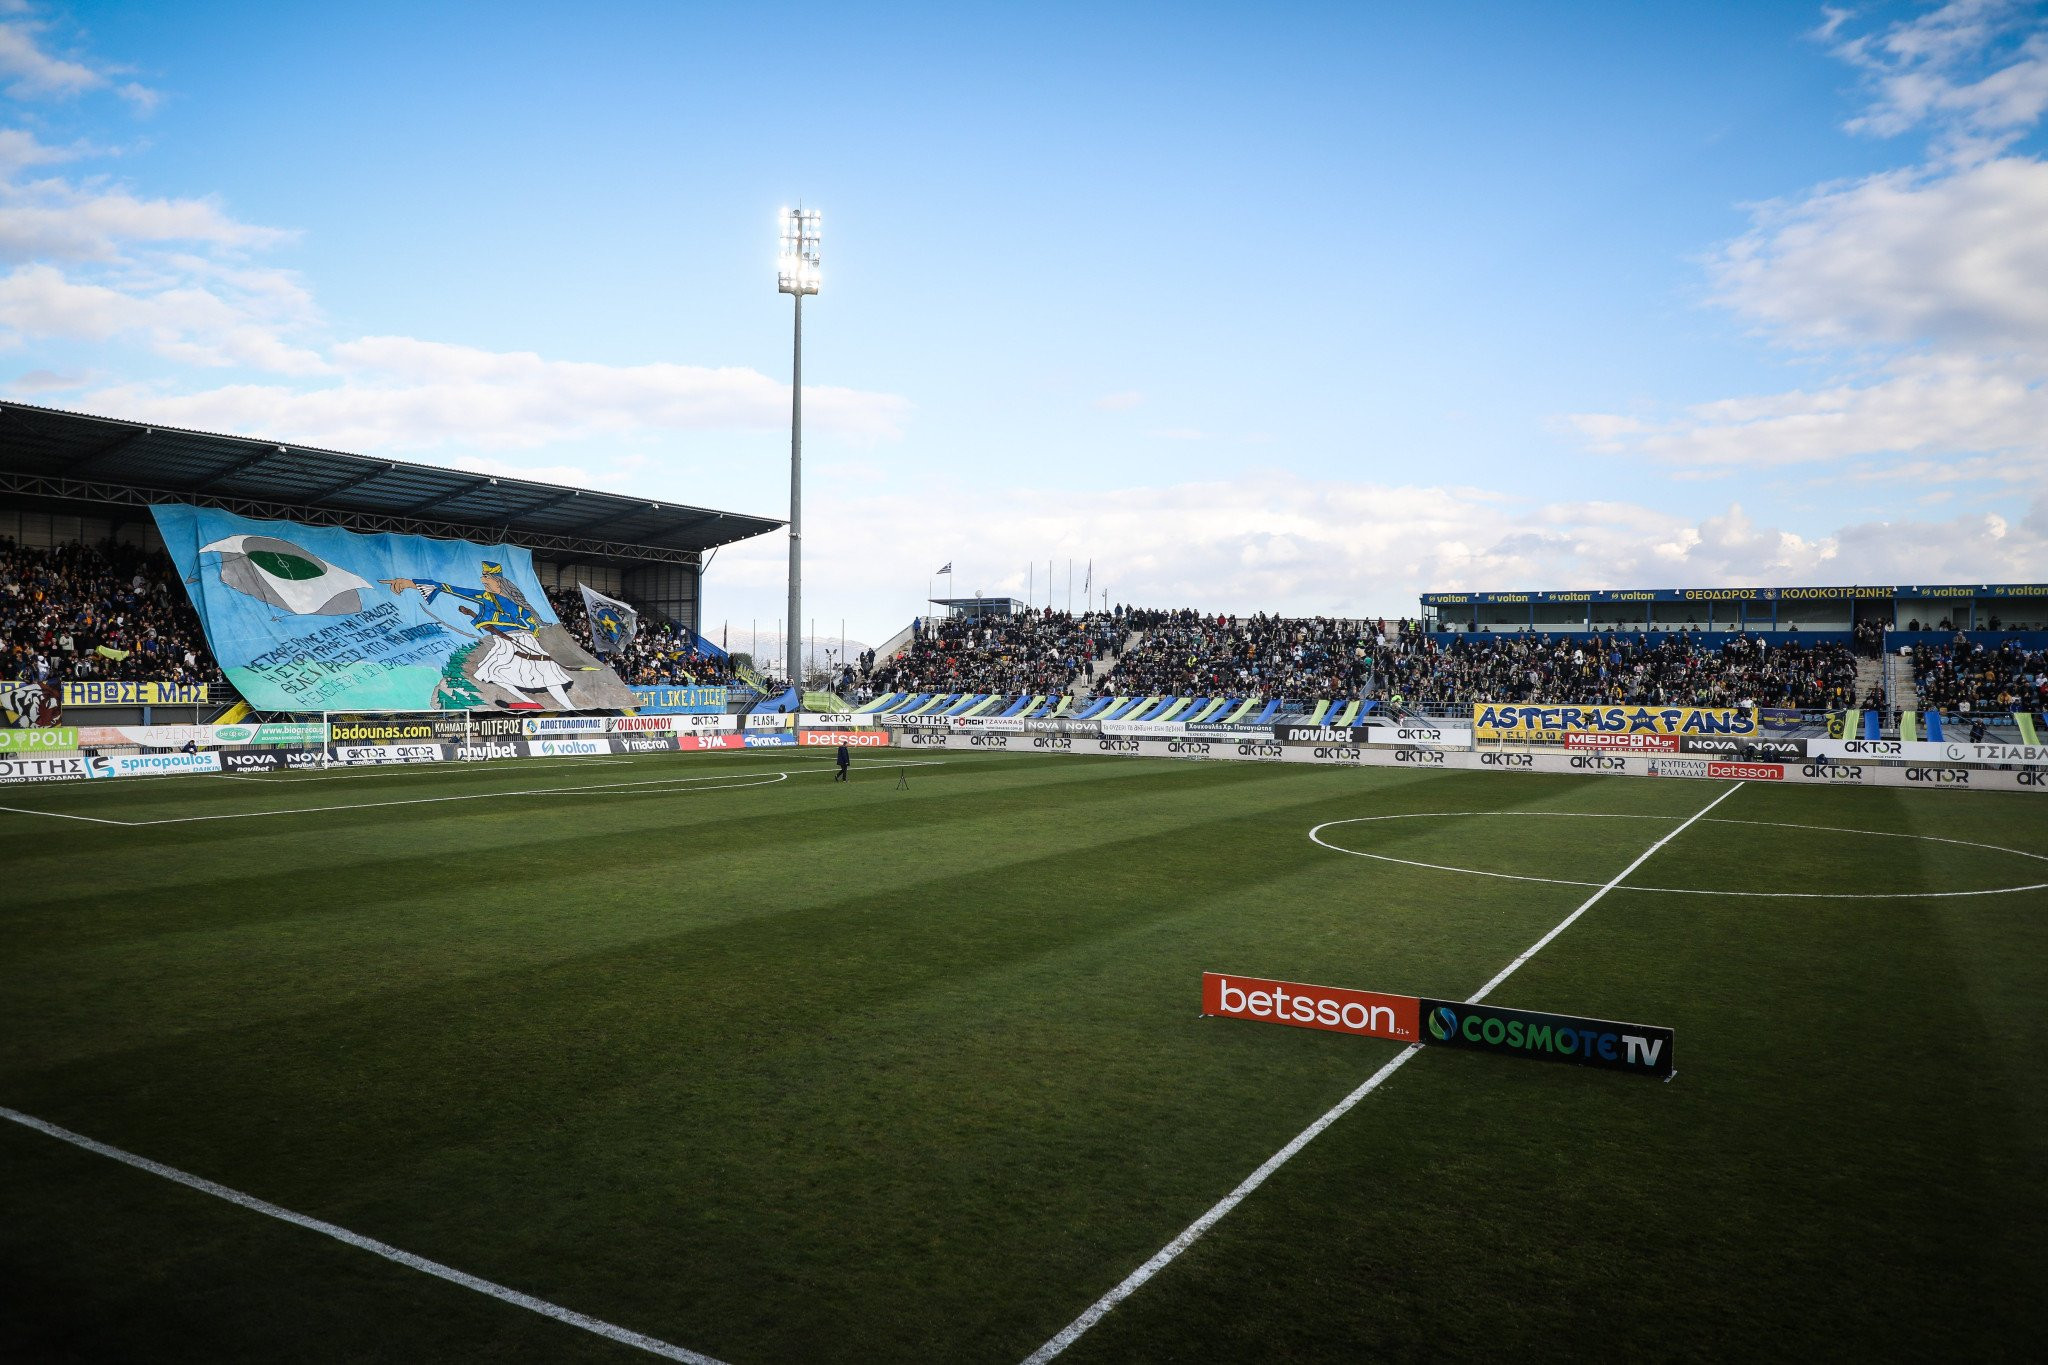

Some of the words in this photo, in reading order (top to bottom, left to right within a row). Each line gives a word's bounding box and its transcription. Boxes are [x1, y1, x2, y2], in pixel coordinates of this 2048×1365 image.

[1620, 591, 1655, 600] volton
[1685, 588, 1757, 600] ΘΕΟΔΩΡΟΣ
[1781, 587, 1894, 599] ΚΟΛΟΚΟΤΡΩΝΗΣ
[1932, 587, 1974, 597] volton
[2007, 585, 2048, 596] volton
[1437, 595, 1468, 603] volton
[1496, 594, 1528, 602] volton
[1557, 592, 1591, 601] volton
[660, 690, 687, 707] LIKE
[690, 691, 698, 706] A
[697, 688, 727, 706] TIGER
[540, 719, 601, 730] ΑΠΟΣΤΟΛΟΠΟΥΛΟΣ
[617, 718, 672, 732] ΟΙΚΟΝΟΜΟΥ
[901, 715, 950, 725] ΚΟΤΤΗΣ
[1477, 706, 1627, 731] ASTERAS
[1659, 708, 1755, 734] FANS
[332, 724, 432, 740] badounas.com
[481, 719, 521, 736] ΠΙΤΕΡΟΣ
[1028, 722, 1060, 731] NOVA
[1066, 722, 1099, 732] NOVA
[29, 731, 73, 747] POLI
[807, 731, 881, 746] betsson
[1288, 727, 1354, 743] novibet
[557, 741, 597, 754] volton
[631, 739, 669, 750] macron
[698, 736, 727, 749] SYM
[1688, 740, 1738, 750] NOVA
[121, 753, 213, 772] spiropoulos
[227, 754, 278, 766] NOVA
[286, 752, 334, 763] NOVA
[1661, 760, 1706, 769] ΚΥΠΕΛΛΟ
[1660, 768, 1706, 777] ΕΛΛΑΔΑΣ
[1710, 764, 1778, 778] betsson
[28, 774, 82, 783] ΣΚΥΡΟΔΕΜΑ
[1219, 979, 1395, 1034] betsson
[1462, 1014, 1618, 1062] COSMOTE
[1622, 1033, 1663, 1067] TV
